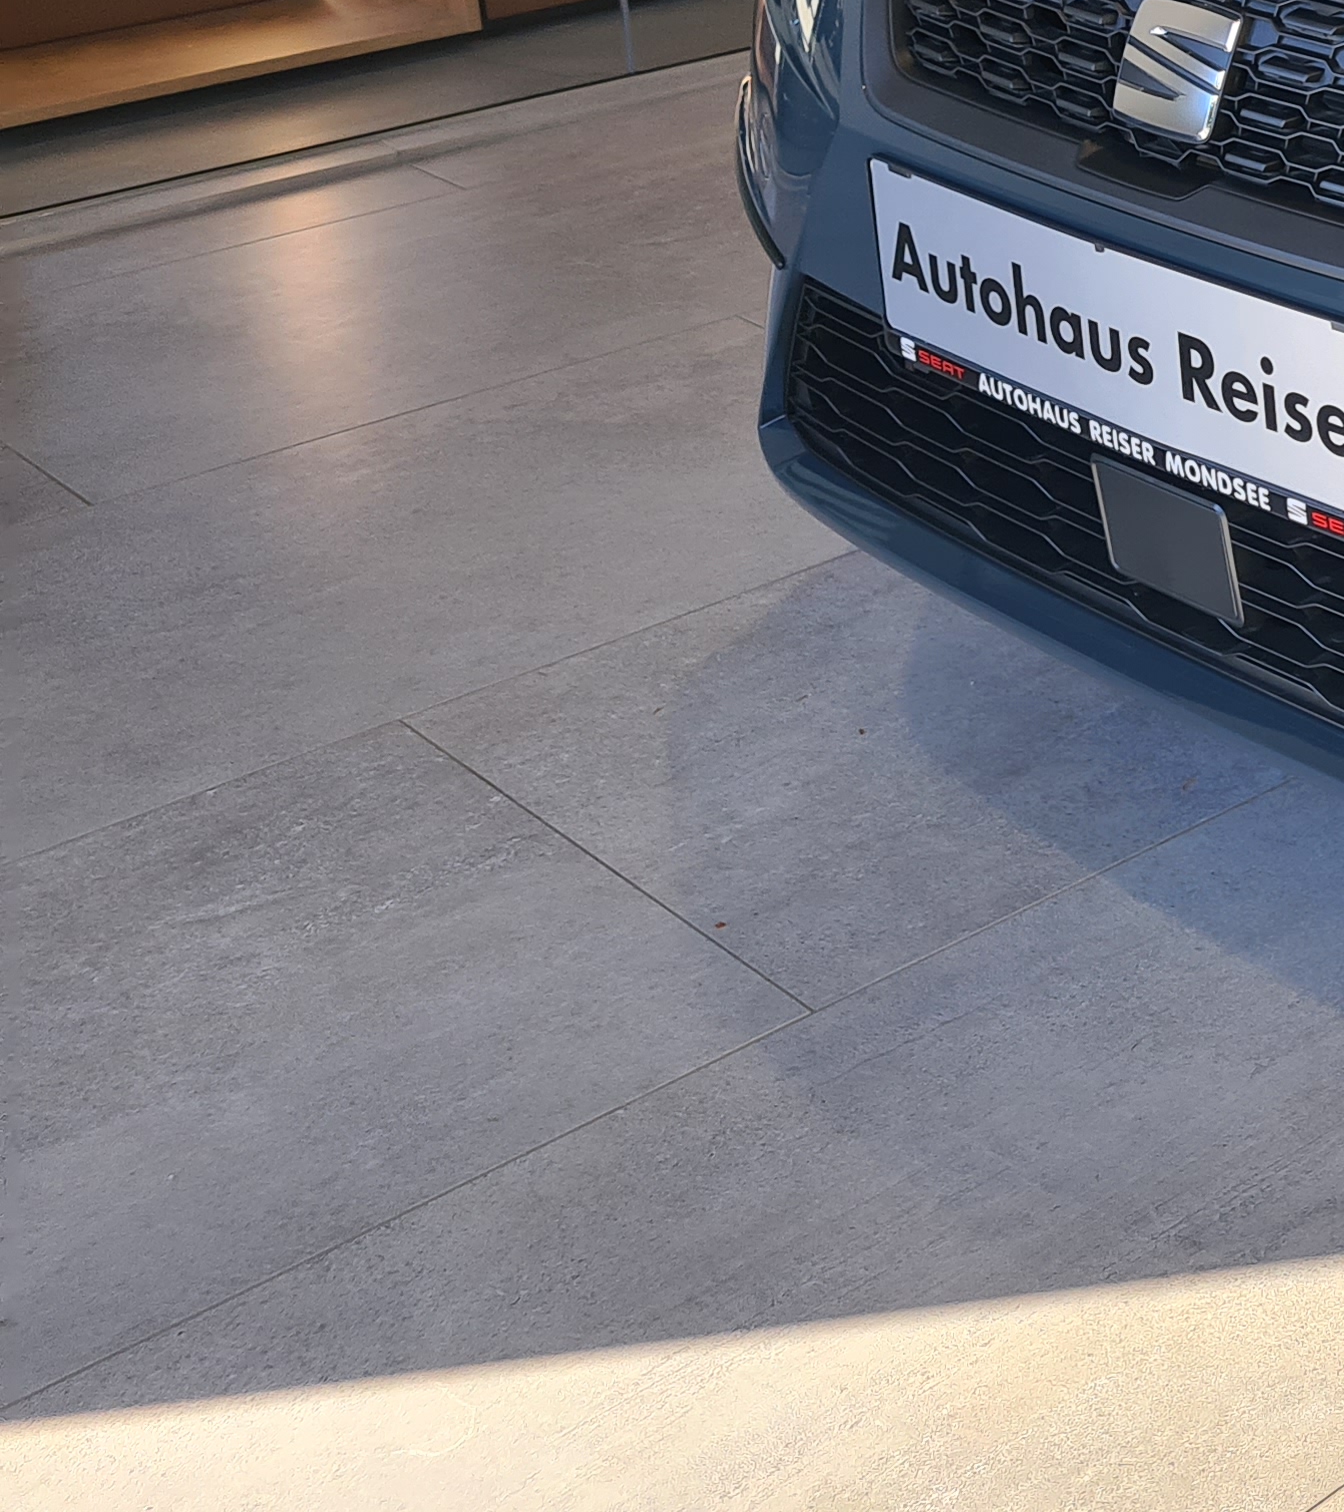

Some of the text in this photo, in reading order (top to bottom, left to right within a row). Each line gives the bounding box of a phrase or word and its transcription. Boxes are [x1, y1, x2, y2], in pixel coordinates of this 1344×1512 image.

[891, 221, 1154, 385] Autohaus
[918, 350, 965, 380] SEAT
[978, 373, 1082, 434] AUTOHAUS
[1089, 419, 1155, 467] REISER
[1165, 450, 1272, 512] MONDSEE
